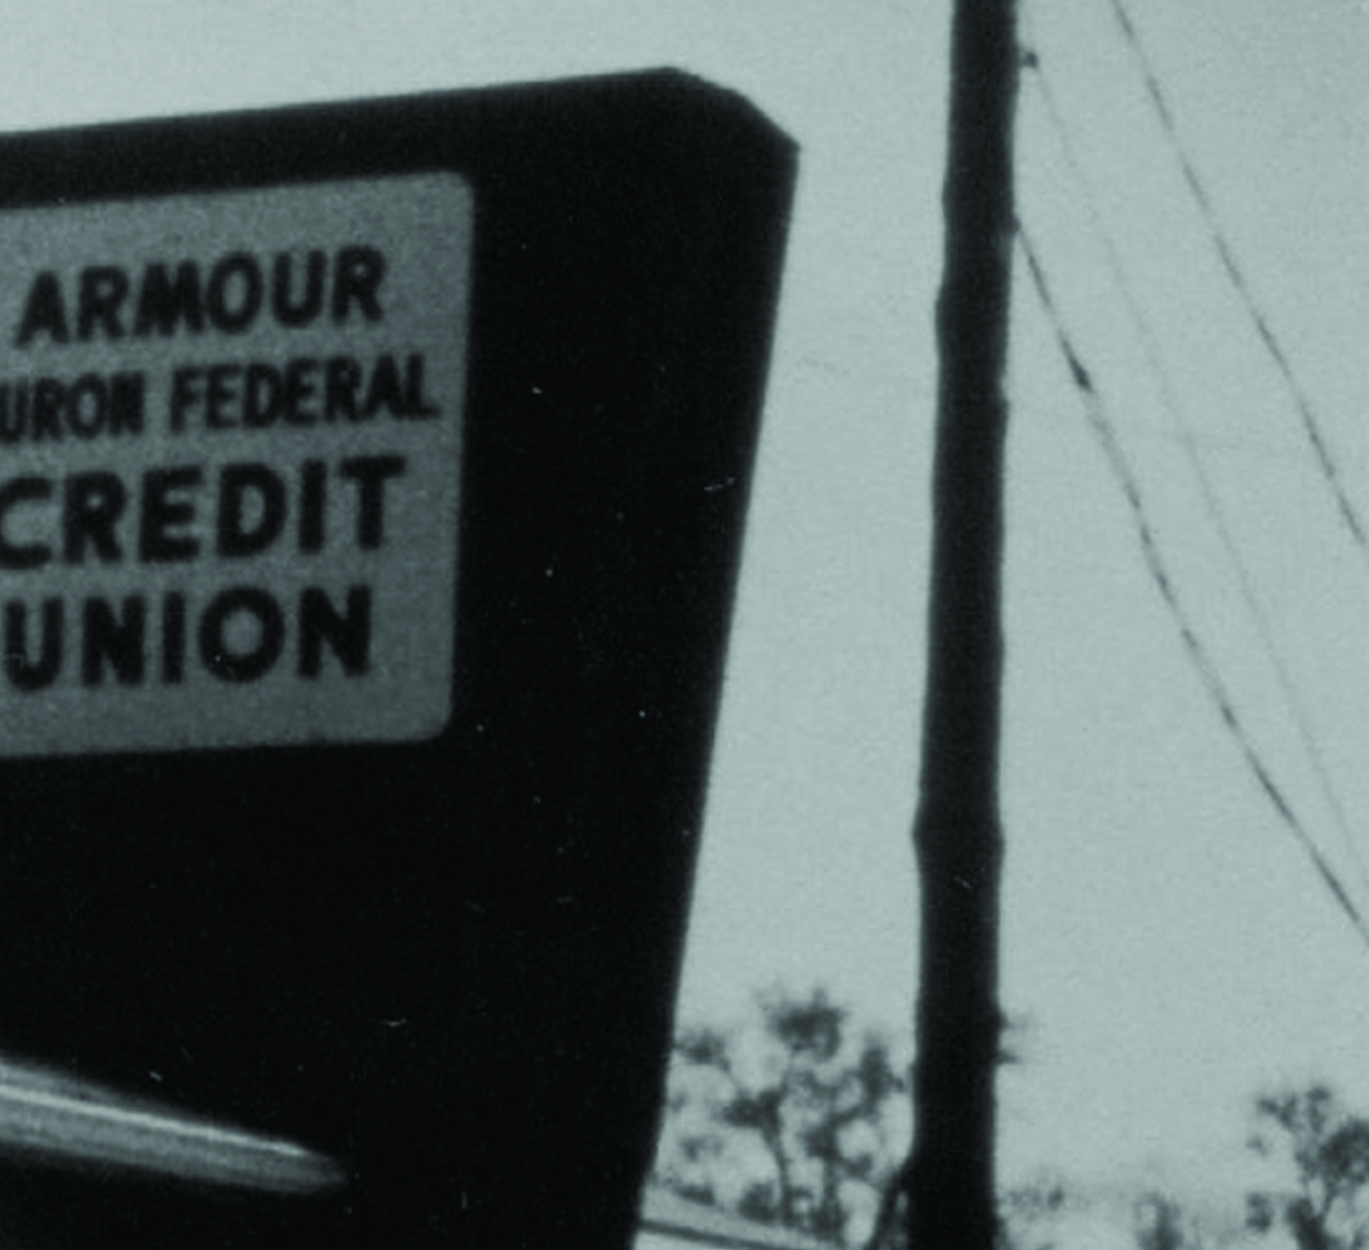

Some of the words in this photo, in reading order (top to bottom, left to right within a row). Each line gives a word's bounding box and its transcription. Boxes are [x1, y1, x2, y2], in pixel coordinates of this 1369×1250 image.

[14, 244, 388, 349] ARMOUR
[168, 352, 442, 436] FEDERAL
[2, 583, 373, 695] UNION
